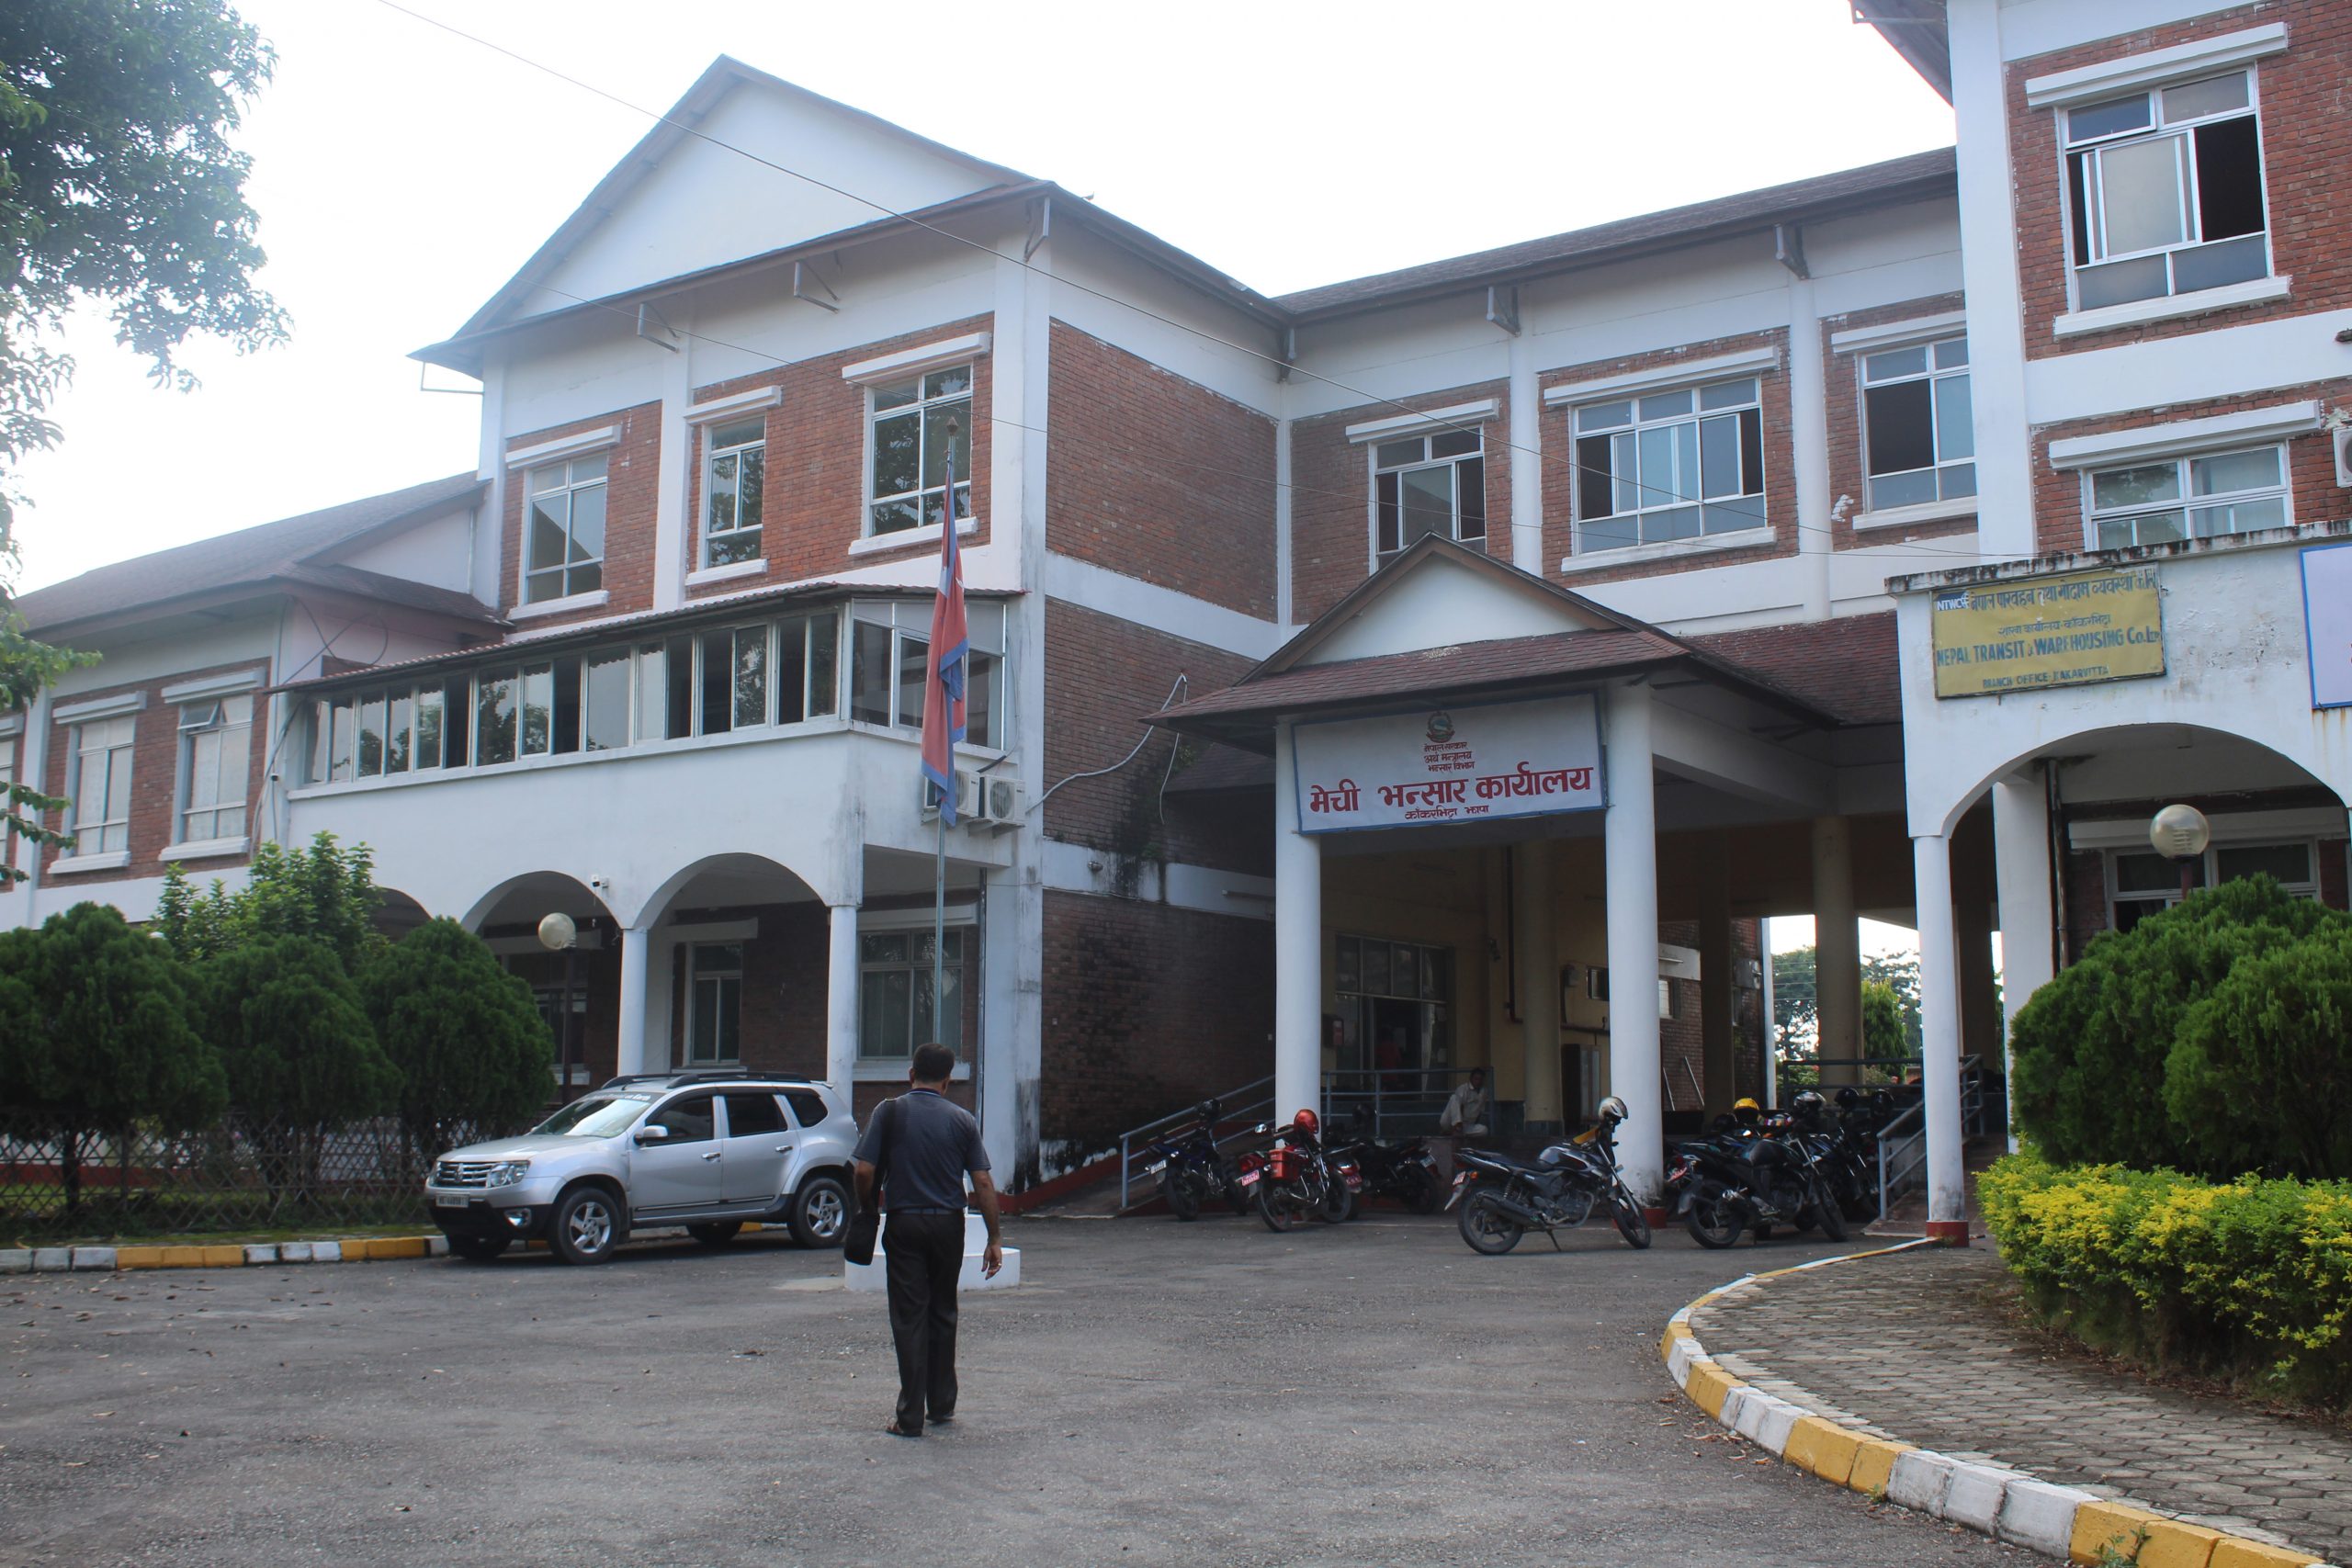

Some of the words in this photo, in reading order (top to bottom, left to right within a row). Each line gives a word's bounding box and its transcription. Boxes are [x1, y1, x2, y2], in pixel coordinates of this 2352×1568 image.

[1936, 647, 1971, 667] NEPAL
[1973, 640, 2025, 663] TRANSIT
[2034, 628, 2124, 655] WAREHOUSING
[1983, 676, 2012, 689] BRANCH
[1428, 762, 1453, 773] भन्सार
[1453, 761, 1476, 771] विभाग
[1310, 778, 1361, 814] मेची
[1377, 778, 1469, 808] भन्सार
[1476, 761, 1594, 800] कार्यालय
[1465, 805, 1489, 816] झापा
